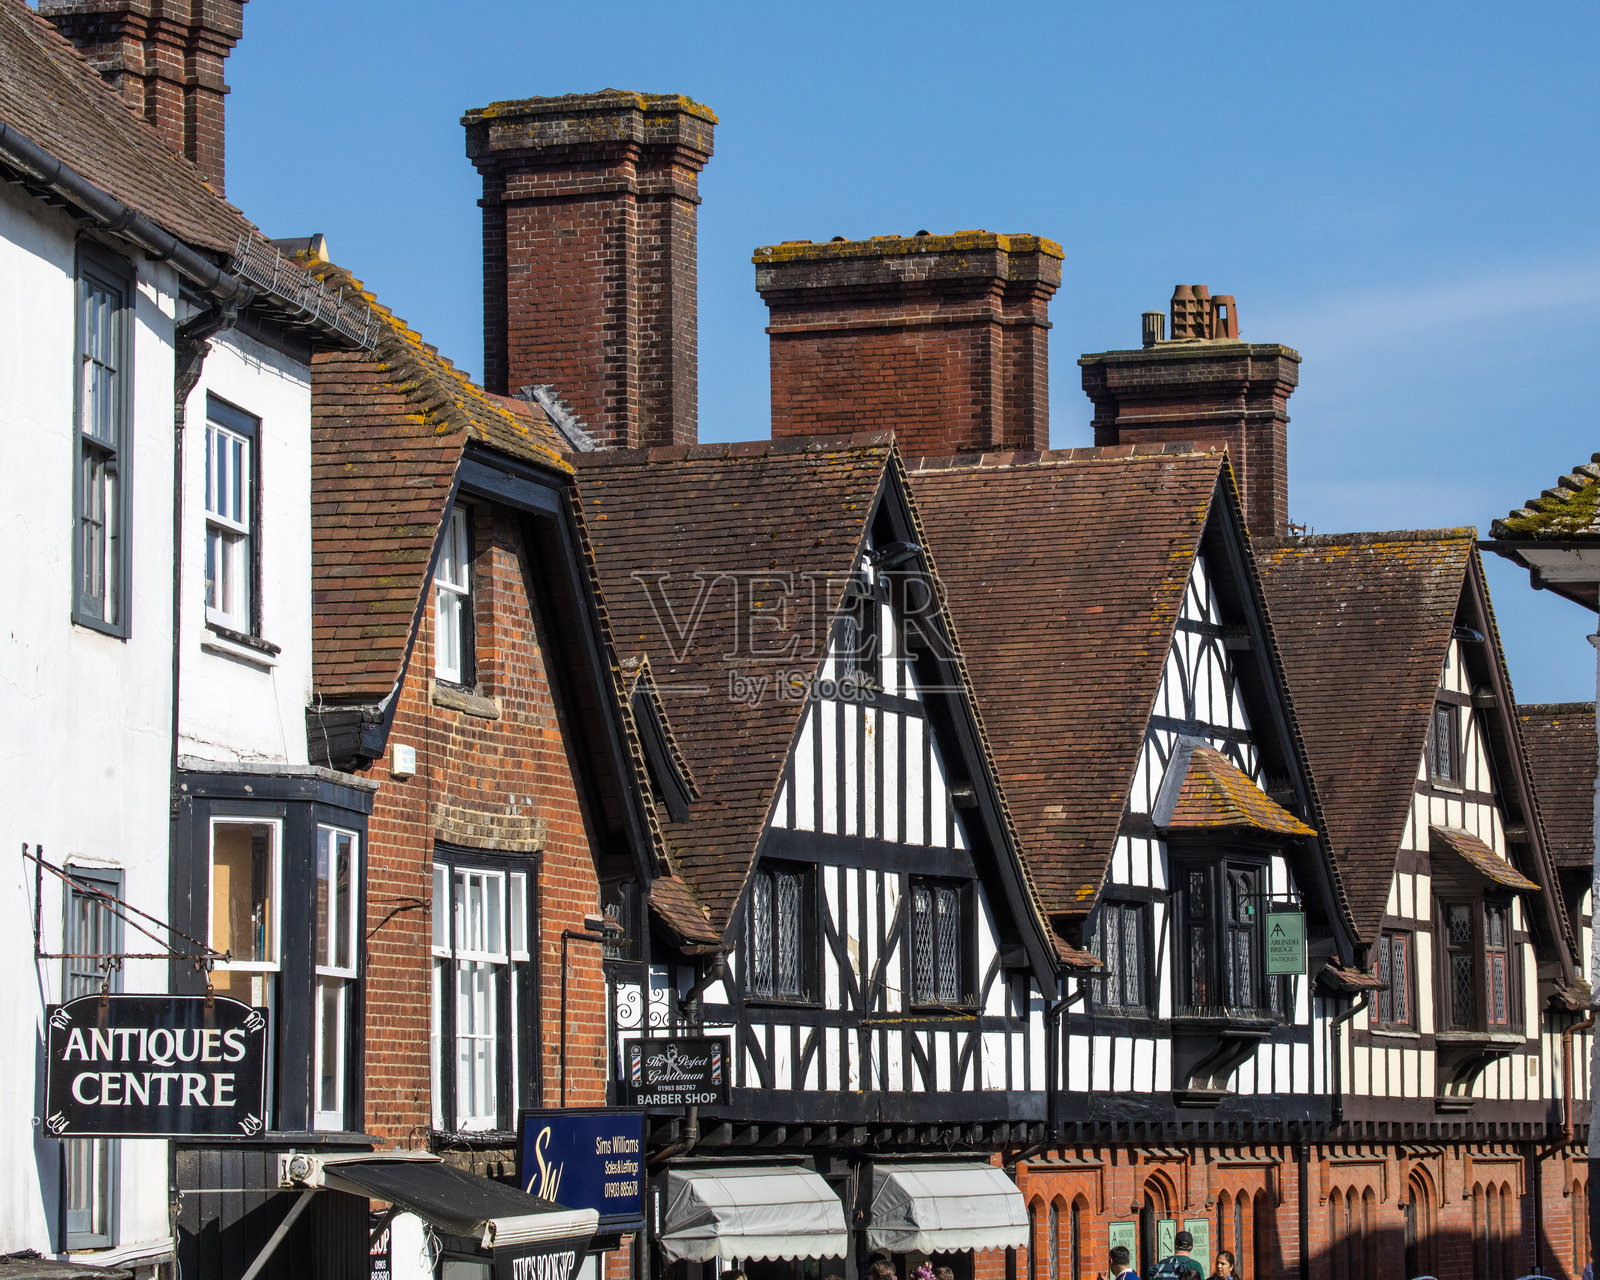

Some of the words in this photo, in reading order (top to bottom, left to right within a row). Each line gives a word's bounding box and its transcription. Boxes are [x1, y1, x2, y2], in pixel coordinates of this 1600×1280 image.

[62, 1027, 246, 1067] ANTIQUES
[645, 1056, 664, 1067] The
[675, 1054, 708, 1069] Perfect
[646, 1069, 704, 1085] Gentleman
[71, 1072, 237, 1107] CENTRE
[637, 1093, 682, 1105] BARBER
[685, 1092, 717, 1104] SHOP
[595, 1136, 611, 1155] Sims
[612, 1135, 639, 1154] Williams
[604, 1182, 619, 1198] 01903
[619, 1181, 638, 1197] 885678
